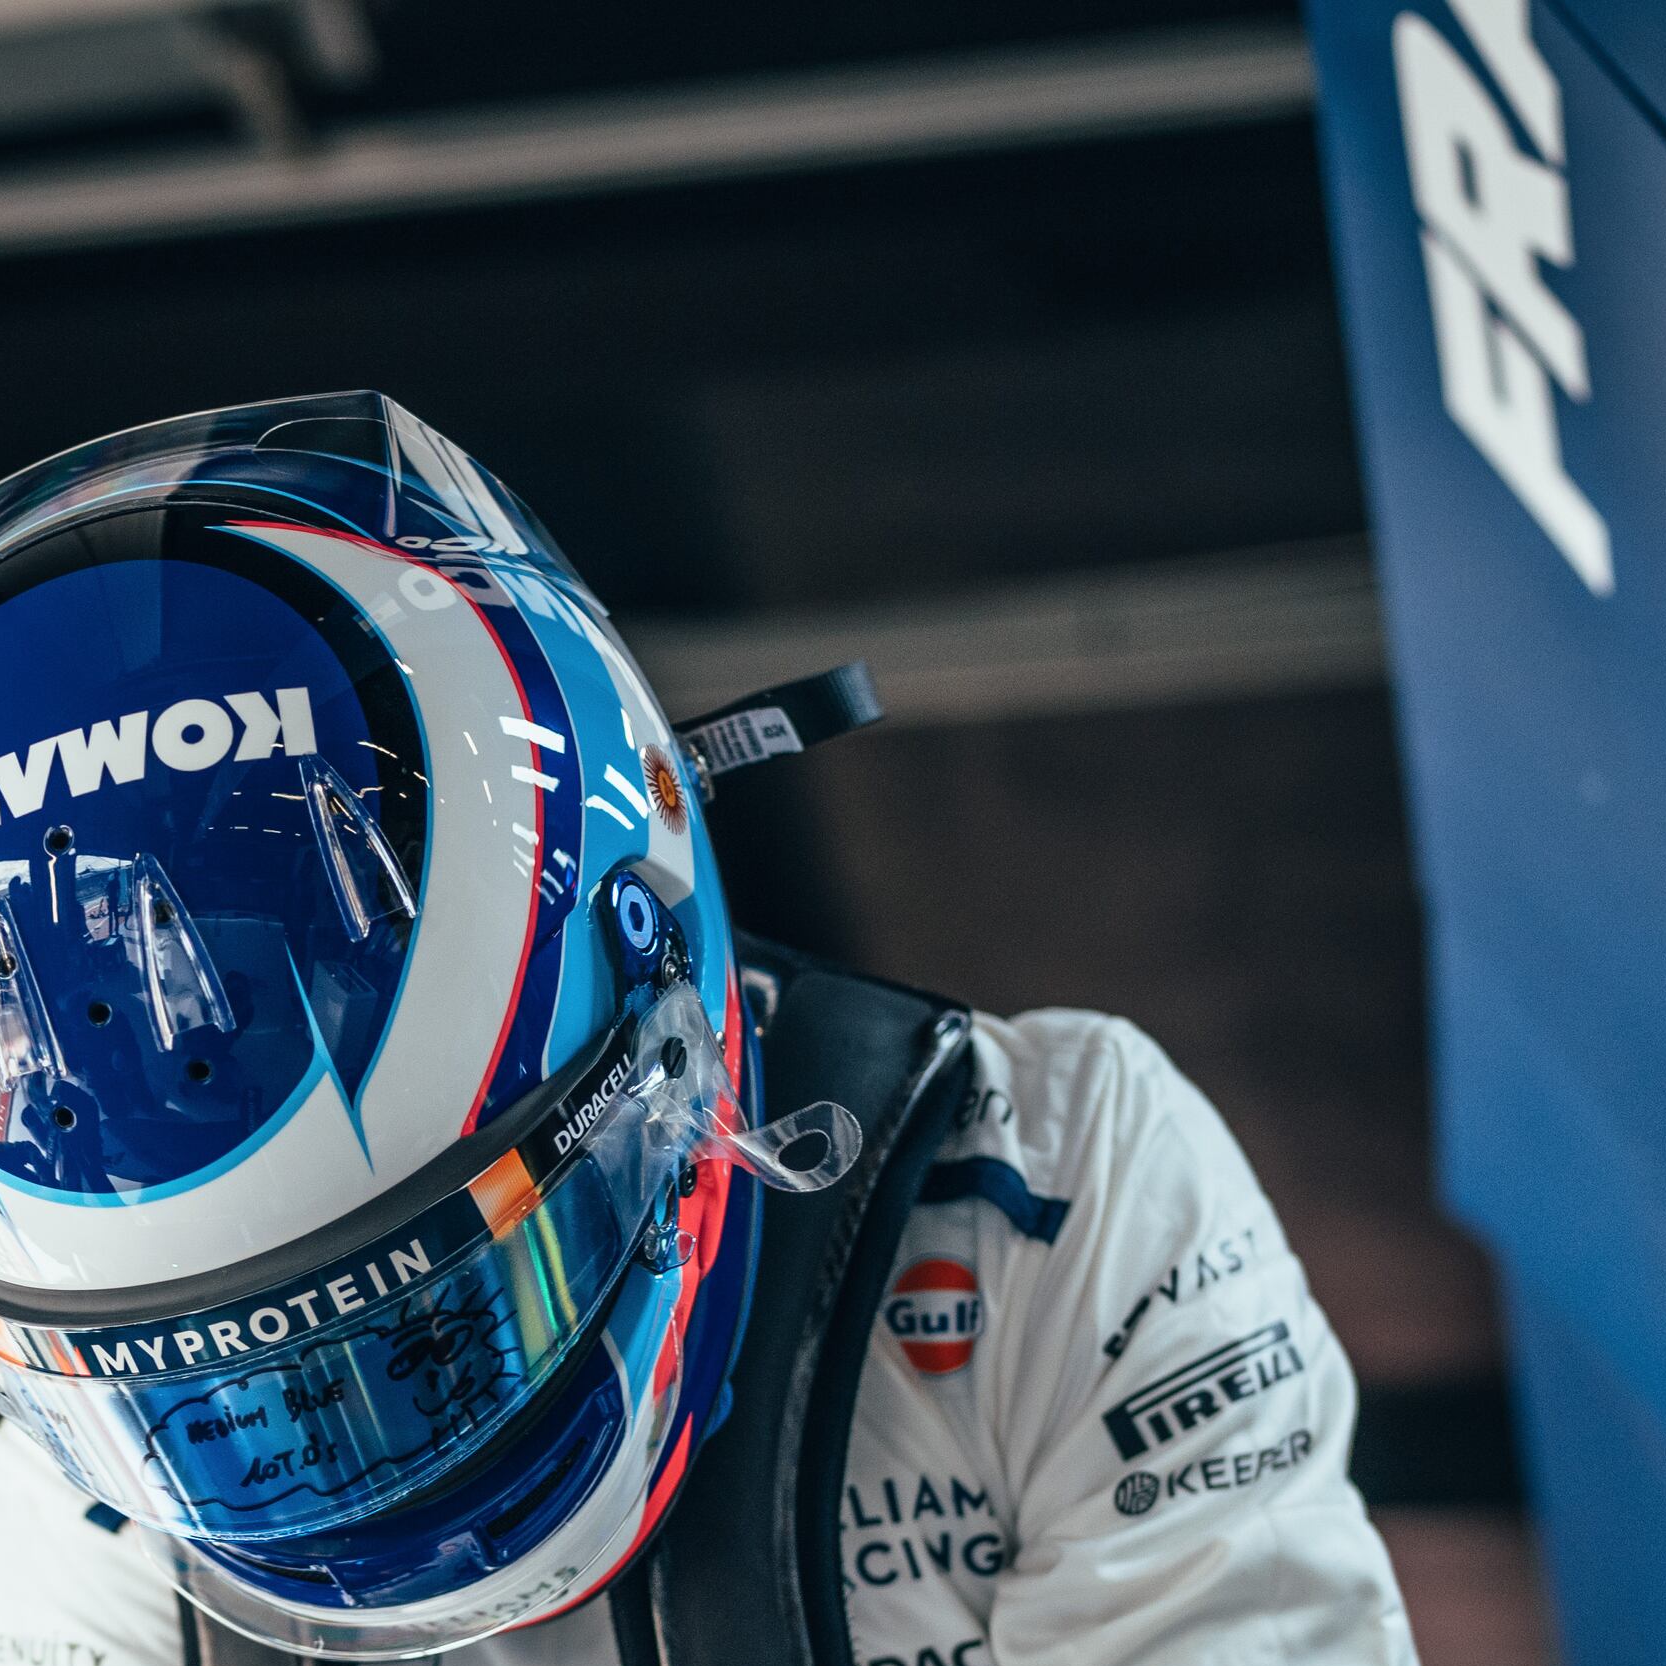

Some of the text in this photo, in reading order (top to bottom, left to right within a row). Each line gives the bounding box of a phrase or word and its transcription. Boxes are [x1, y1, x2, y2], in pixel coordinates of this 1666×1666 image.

[91, 1238, 433, 1376] MYPROTEIN
[885, 1297, 980, 1335] Gulf
[1102, 1319, 1304, 1462] PIRELLI
